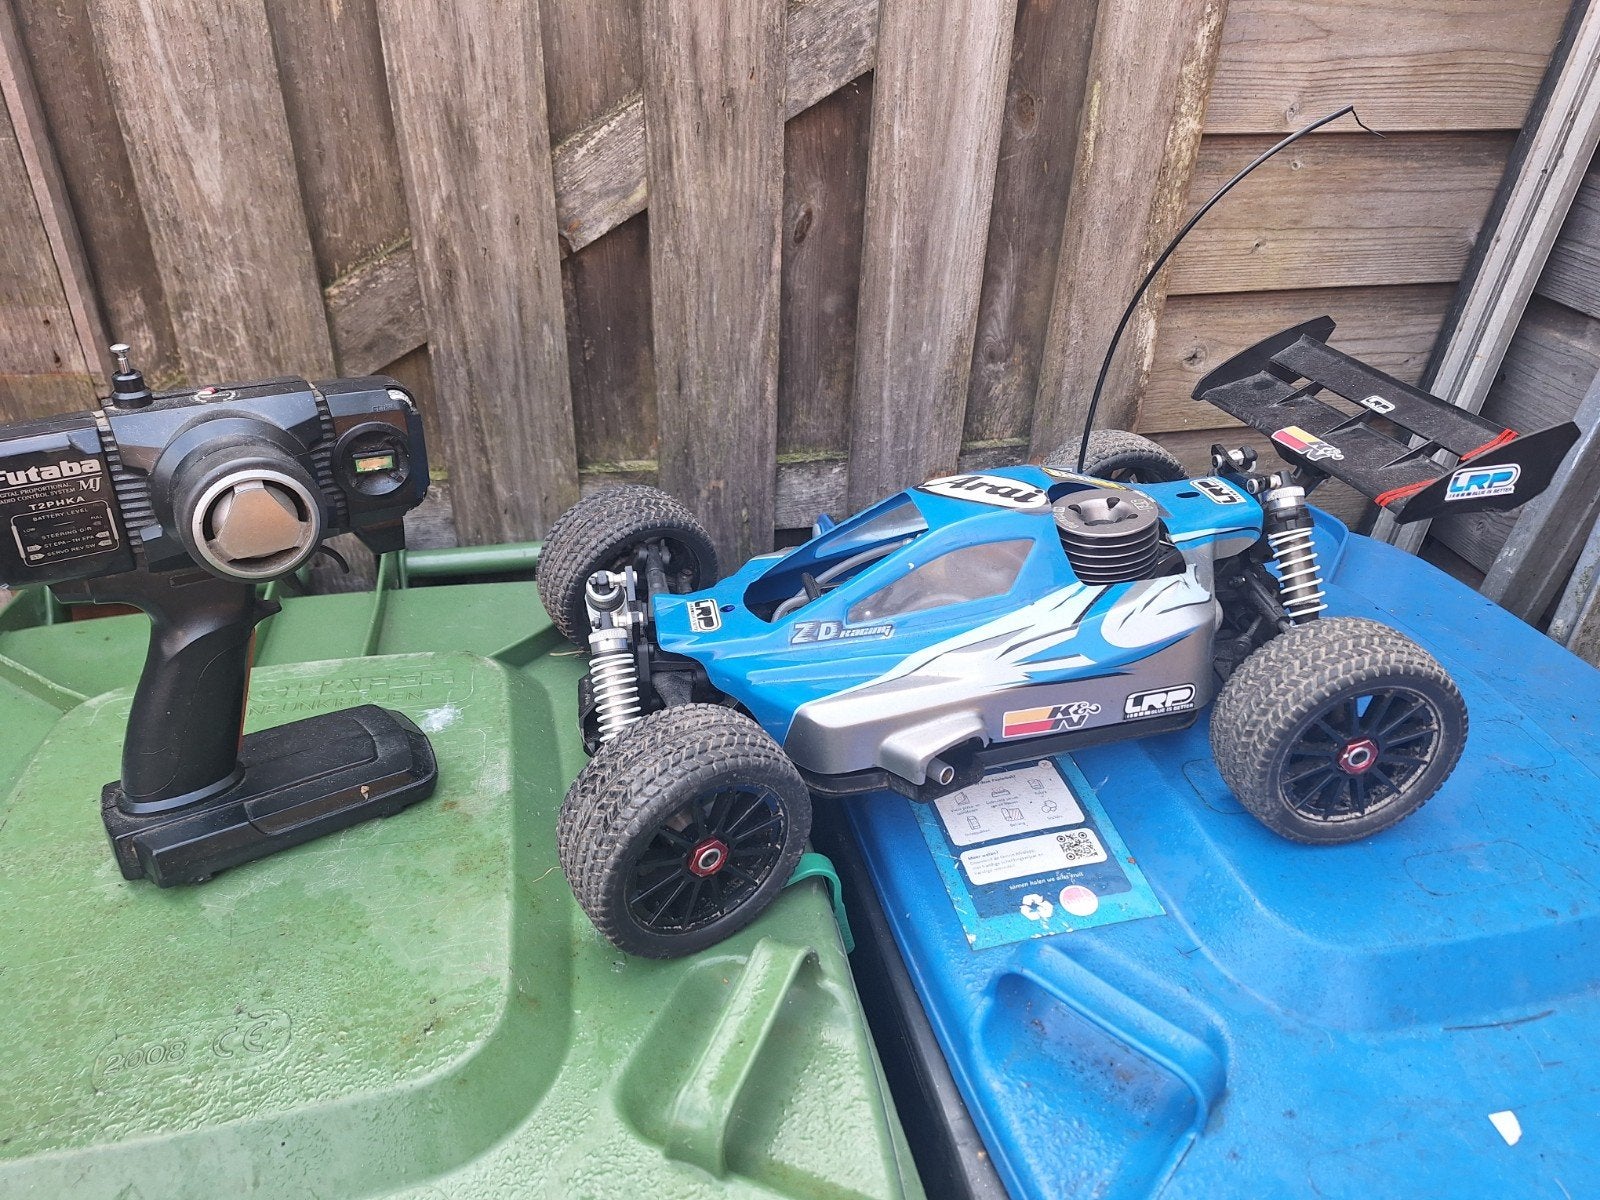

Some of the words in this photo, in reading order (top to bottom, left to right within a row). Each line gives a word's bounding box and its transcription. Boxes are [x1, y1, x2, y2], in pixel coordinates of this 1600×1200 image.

[1364, 398, 1391, 410] LRP
[0, 491, 19, 499] GITAL
[20, 482, 71, 496] PROPORTIONAL
[77, 477, 102, 491] MJ
[932, 476, 1044, 503] Arai
[1450, 471, 1514, 492] LRP
[17, 492, 49, 502] CONTROL
[50, 487, 76, 497] SYSTEM
[1197, 481, 1238, 503] LRP
[28, 496, 85, 511] T2PHKA
[32, 511, 64, 522] BATTERY
[66, 507, 88, 516] LEVEL
[41, 529, 77, 541] STEERING
[47, 548, 70, 557] SERVO
[694, 599, 715, 628] LRP
[791, 621, 841, 645] ZD
[1125, 687, 1193, 714] LRP
[1047, 702, 1100, 730] K&N
[100, 1040, 188, 1076] 2008
